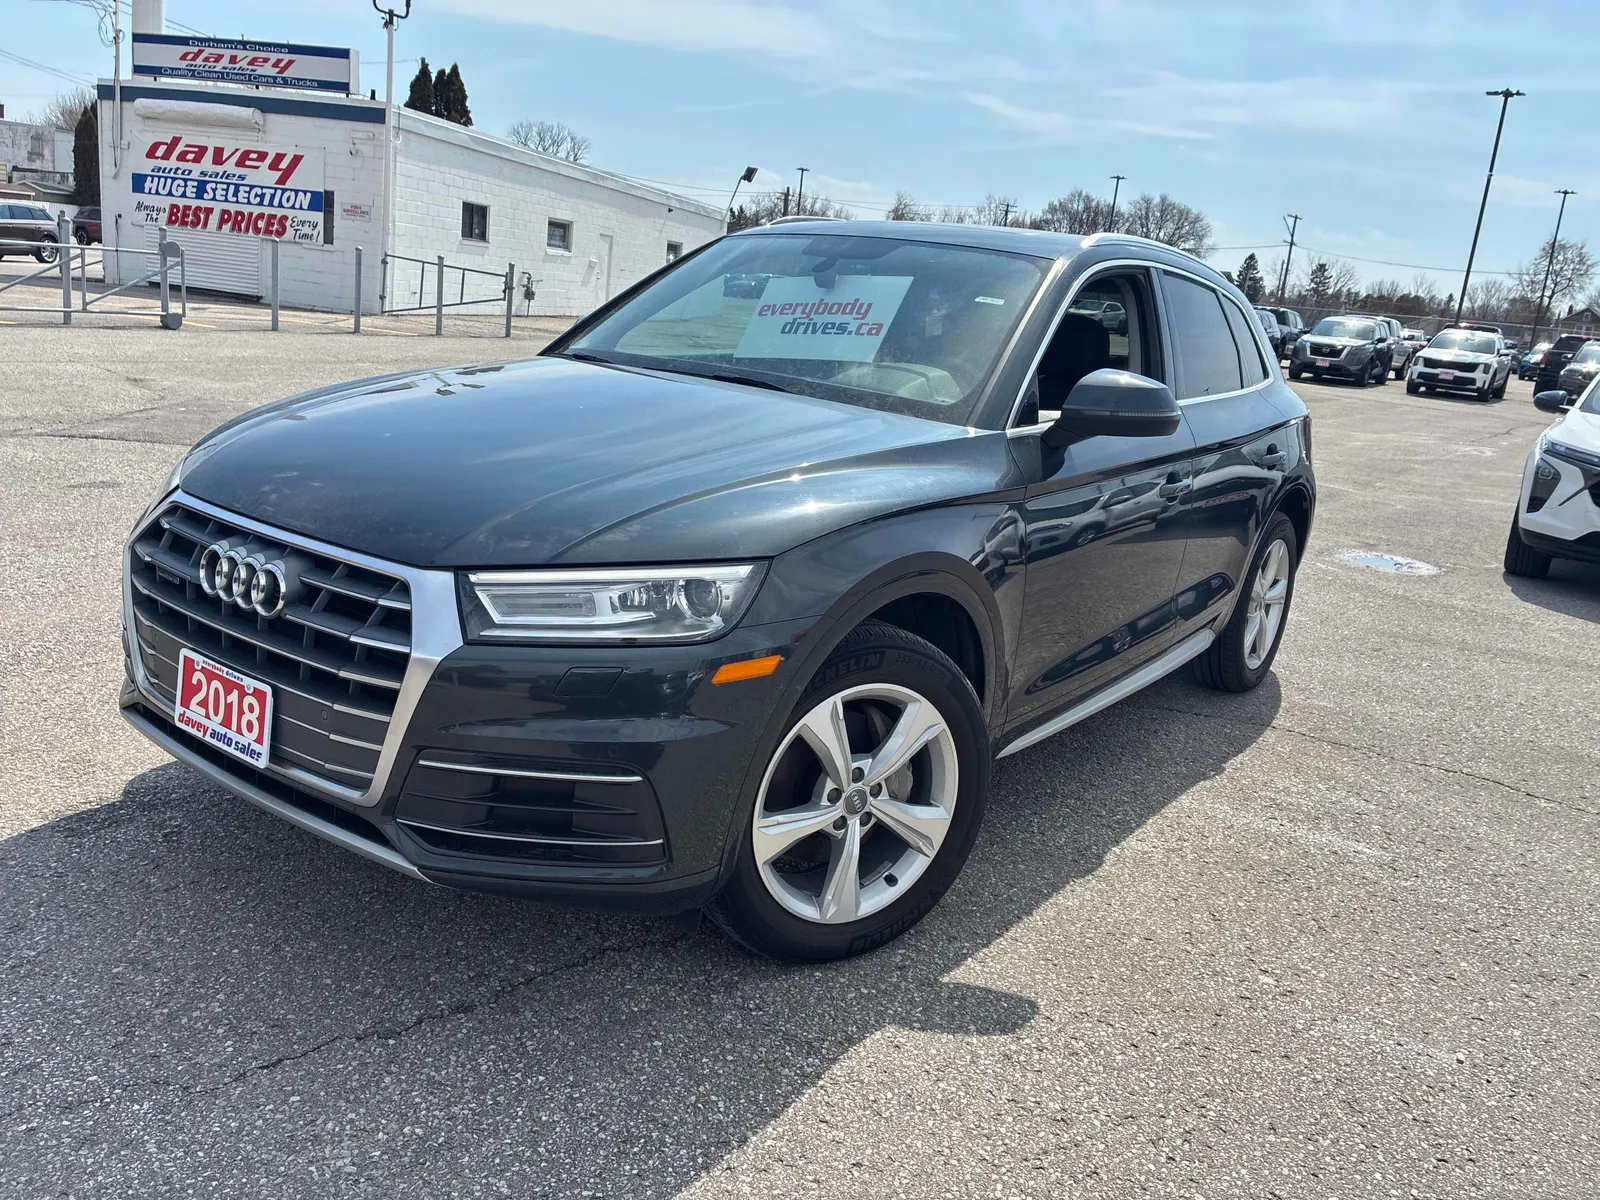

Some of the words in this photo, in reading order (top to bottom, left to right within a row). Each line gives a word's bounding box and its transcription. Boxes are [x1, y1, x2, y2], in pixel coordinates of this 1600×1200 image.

[189, 39, 244, 50] Durham's
[246, 44, 289, 53] Choice
[179, 48, 296, 75] davey
[185, 62, 217, 70] auto
[221, 65, 258, 73] sales
[161, 67, 193, 77] Quality
[194, 70, 222, 79] Clean
[224, 73, 249, 81] Used
[251, 75, 274, 84] Cars
[275, 77, 284, 85] &
[285, 77, 318, 88] Trucks
[145, 136, 305, 186] davey
[150, 165, 193, 177] auto
[198, 170, 248, 182] sales
[144, 176, 198, 198] HUGE
[203, 181, 311, 210] SELECTION
[135, 200, 167, 215] Always
[145, 213, 159, 223] The
[166, 203, 215, 229] BEST
[216, 208, 289, 238] PRICES
[290, 216, 319, 230] Every
[293, 228, 321, 243] Time!
[757, 298, 873, 320] everybody
[780, 317, 884, 337] drives.ca
[202, 659, 225, 675] everybody
[225, 670, 244, 682] drives
[189, 671, 260, 741] 2018
[177, 710, 210, 738] davey
[209, 727, 234, 748] auto
[233, 741, 263, 762] sales
